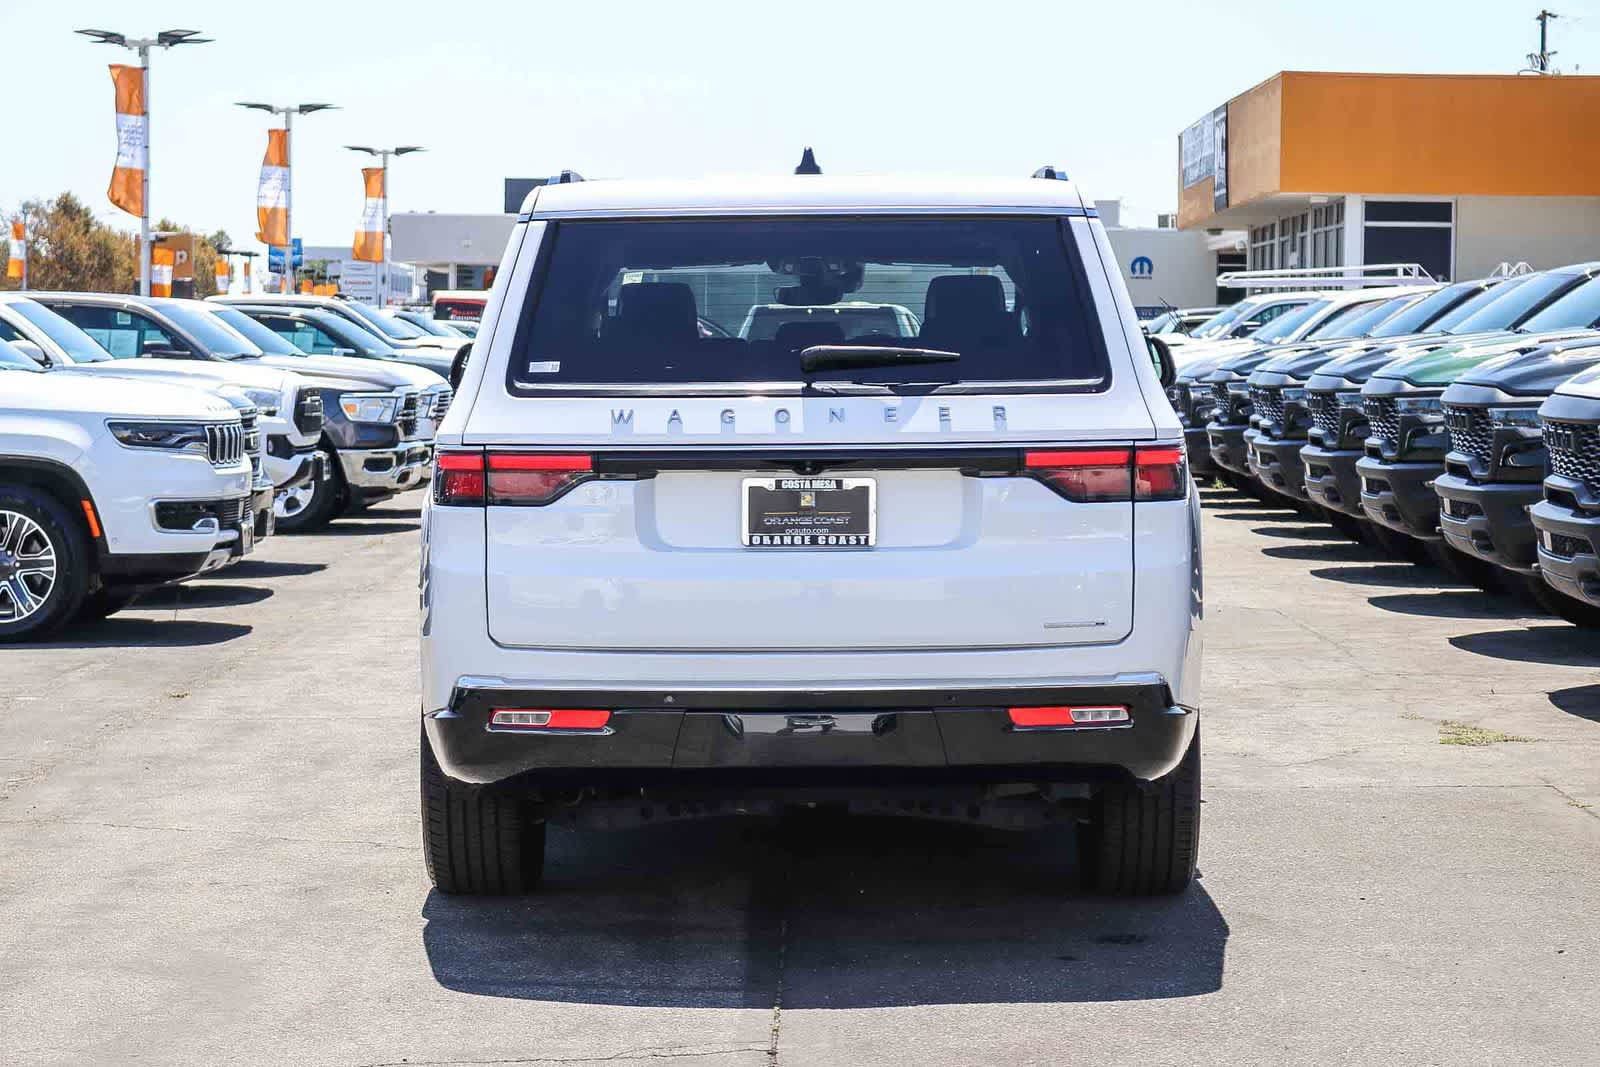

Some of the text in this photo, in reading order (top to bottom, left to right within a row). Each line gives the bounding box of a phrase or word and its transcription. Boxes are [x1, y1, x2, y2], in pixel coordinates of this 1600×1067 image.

[610, 406, 1008, 425] WAGONEER
[781, 479, 837, 489] COSTA MESA
[813, 516, 850, 525] COAST
[785, 527, 829, 535] ocauto.com
[752, 535, 866, 545] ORANGE COAST
